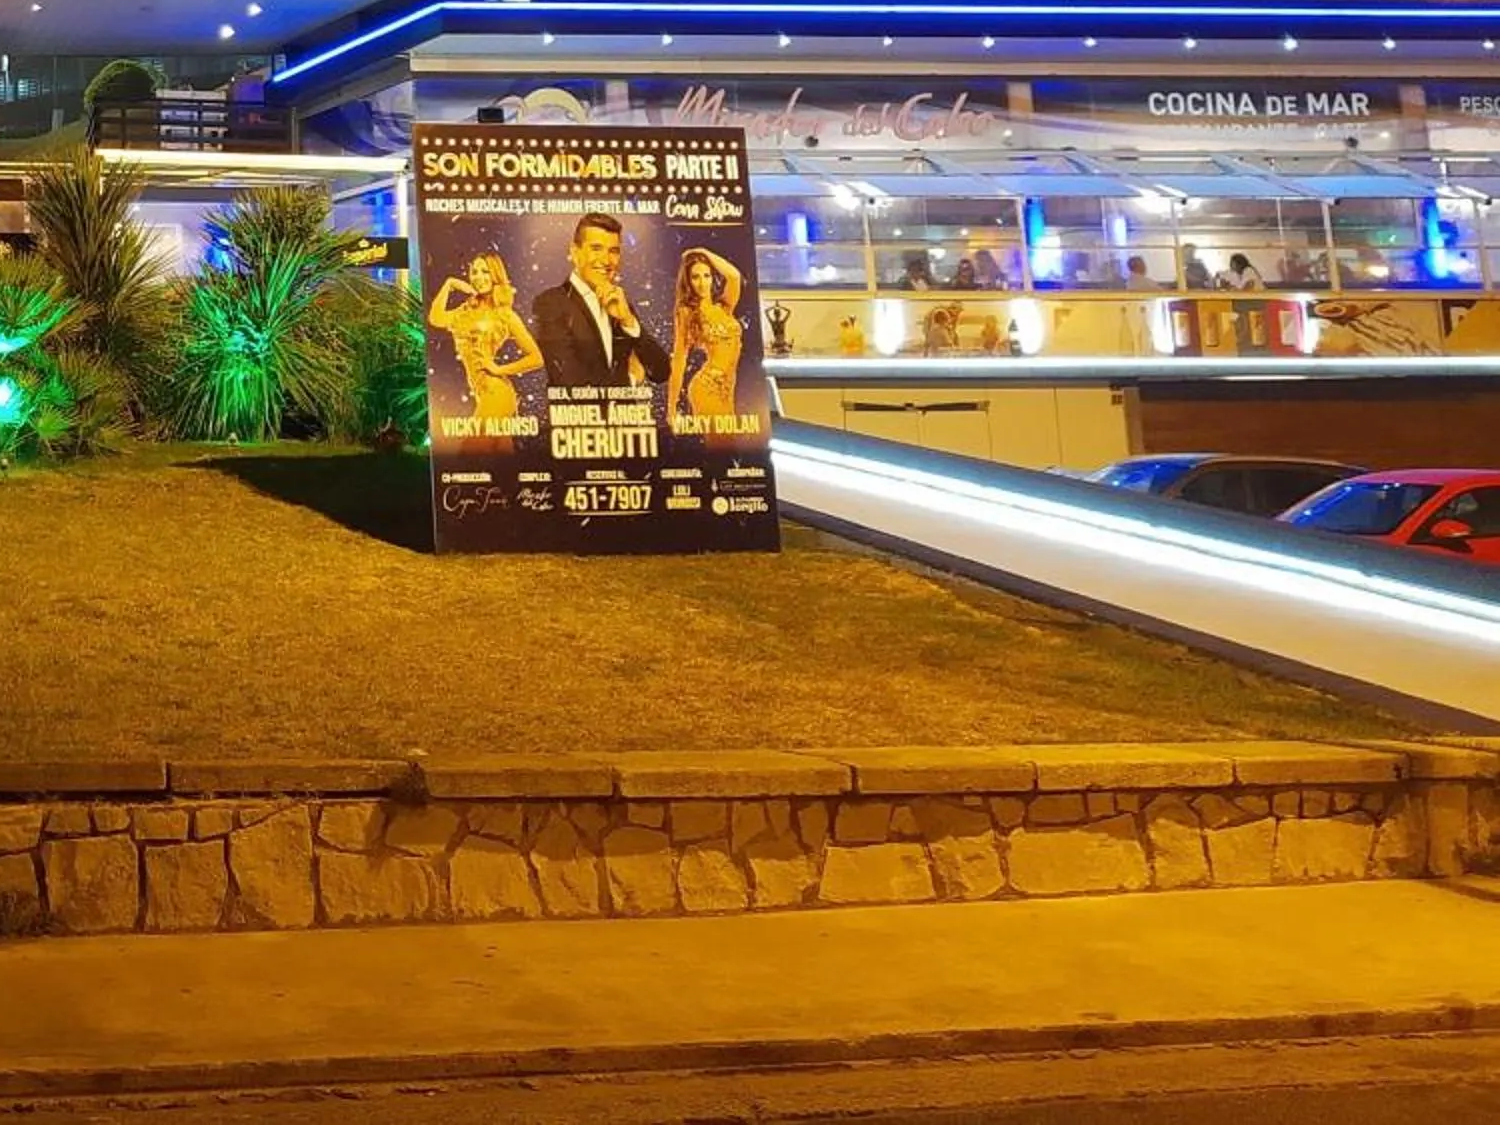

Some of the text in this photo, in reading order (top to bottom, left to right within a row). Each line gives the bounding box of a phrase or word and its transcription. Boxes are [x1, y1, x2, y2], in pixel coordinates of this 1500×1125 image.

[1148, 92, 1370, 116] COCINA DE MAR
[423, 152, 740, 179] SON FORMIDABLES PARTE II
[425, 198, 465, 212] NOCHES
[531, 199, 547, 213] DE
[548, 199, 583, 213] HUMOR
[584, 199, 623, 213] FRENTE
[637, 200, 661, 213] MAR
[704, 196, 744, 220] Show
[549, 401, 657, 426] MIGUEL ÁNGEL
[671, 415, 760, 435] VICKY DOLAN
[441, 416, 540, 437] VICKY ALONSO
[551, 427, 658, 459] CHERUTTI
[563, 486, 652, 510] 451-7907
